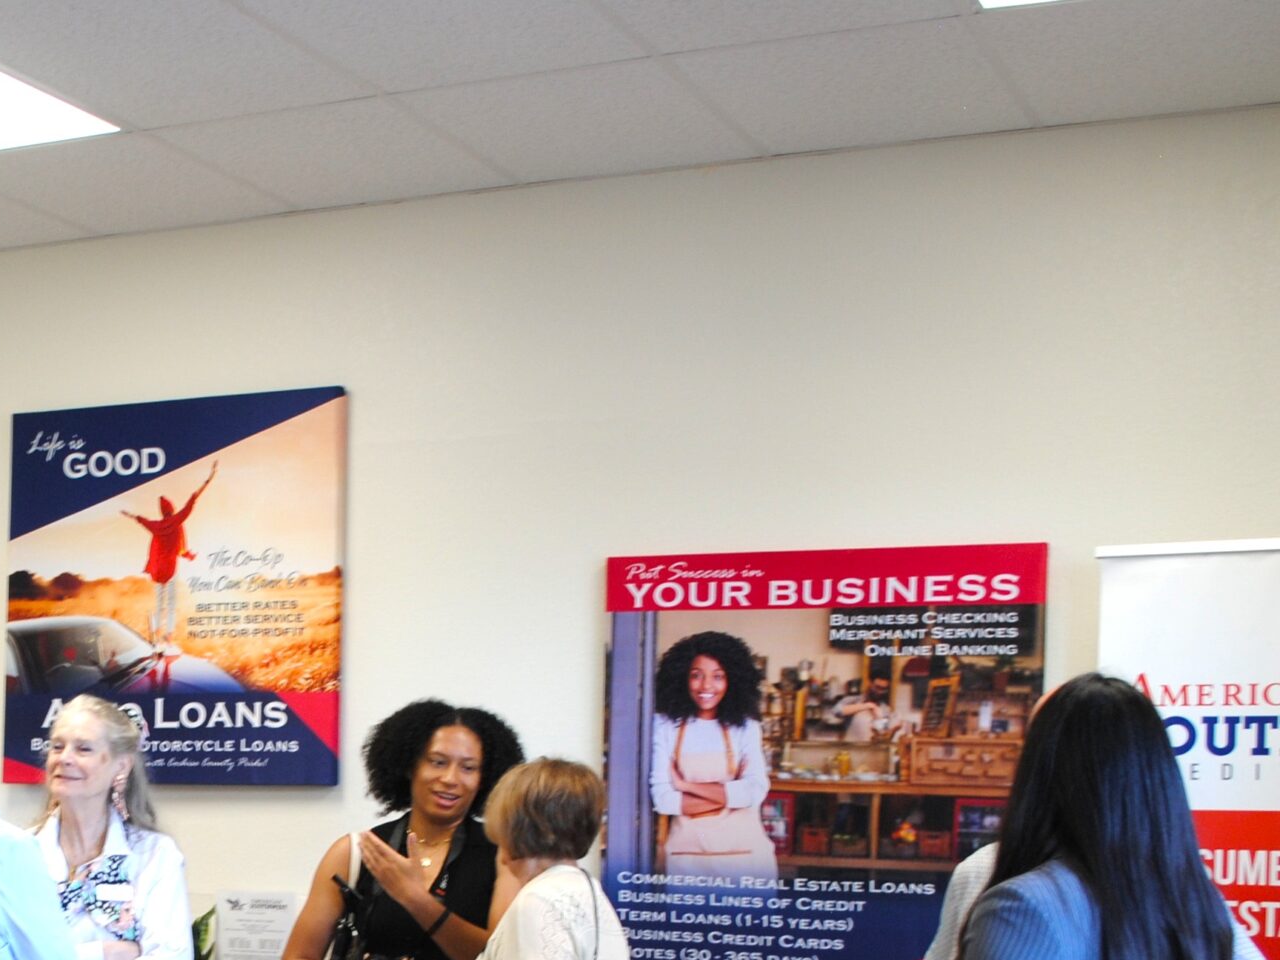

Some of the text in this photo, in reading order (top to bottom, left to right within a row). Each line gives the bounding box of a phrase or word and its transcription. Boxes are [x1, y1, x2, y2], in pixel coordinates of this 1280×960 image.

[27, 431, 86, 461] Life is
[62, 447, 166, 479] GOOD
[624, 562, 765, 581] Put Success in
[624, 573, 1021, 608] YOUR BUSINESS
[195, 600, 298, 613] BETTER RATES
[187, 613, 304, 626] BETTER SERVICE
[830, 611, 1019, 627] BUSINESS CHECKING
[829, 626, 1019, 641] MERCHANT SERVICES
[864, 643, 1019, 657] ONLINE BANKING
[154, 697, 288, 729] LOANS
[240, 738, 299, 753] LOANS
[617, 871, 936, 895] COMMERCIAL REAL ESTATE LOANS
[617, 890, 866, 912] BUSINESS LINES OF CREDIT
[616, 908, 854, 932] TERM LOANS (1-15 YEARS)
[707, 931, 774, 947] CREDIT
[778, 935, 845, 950] CARDS
[629, 946, 677, 960] OTES
